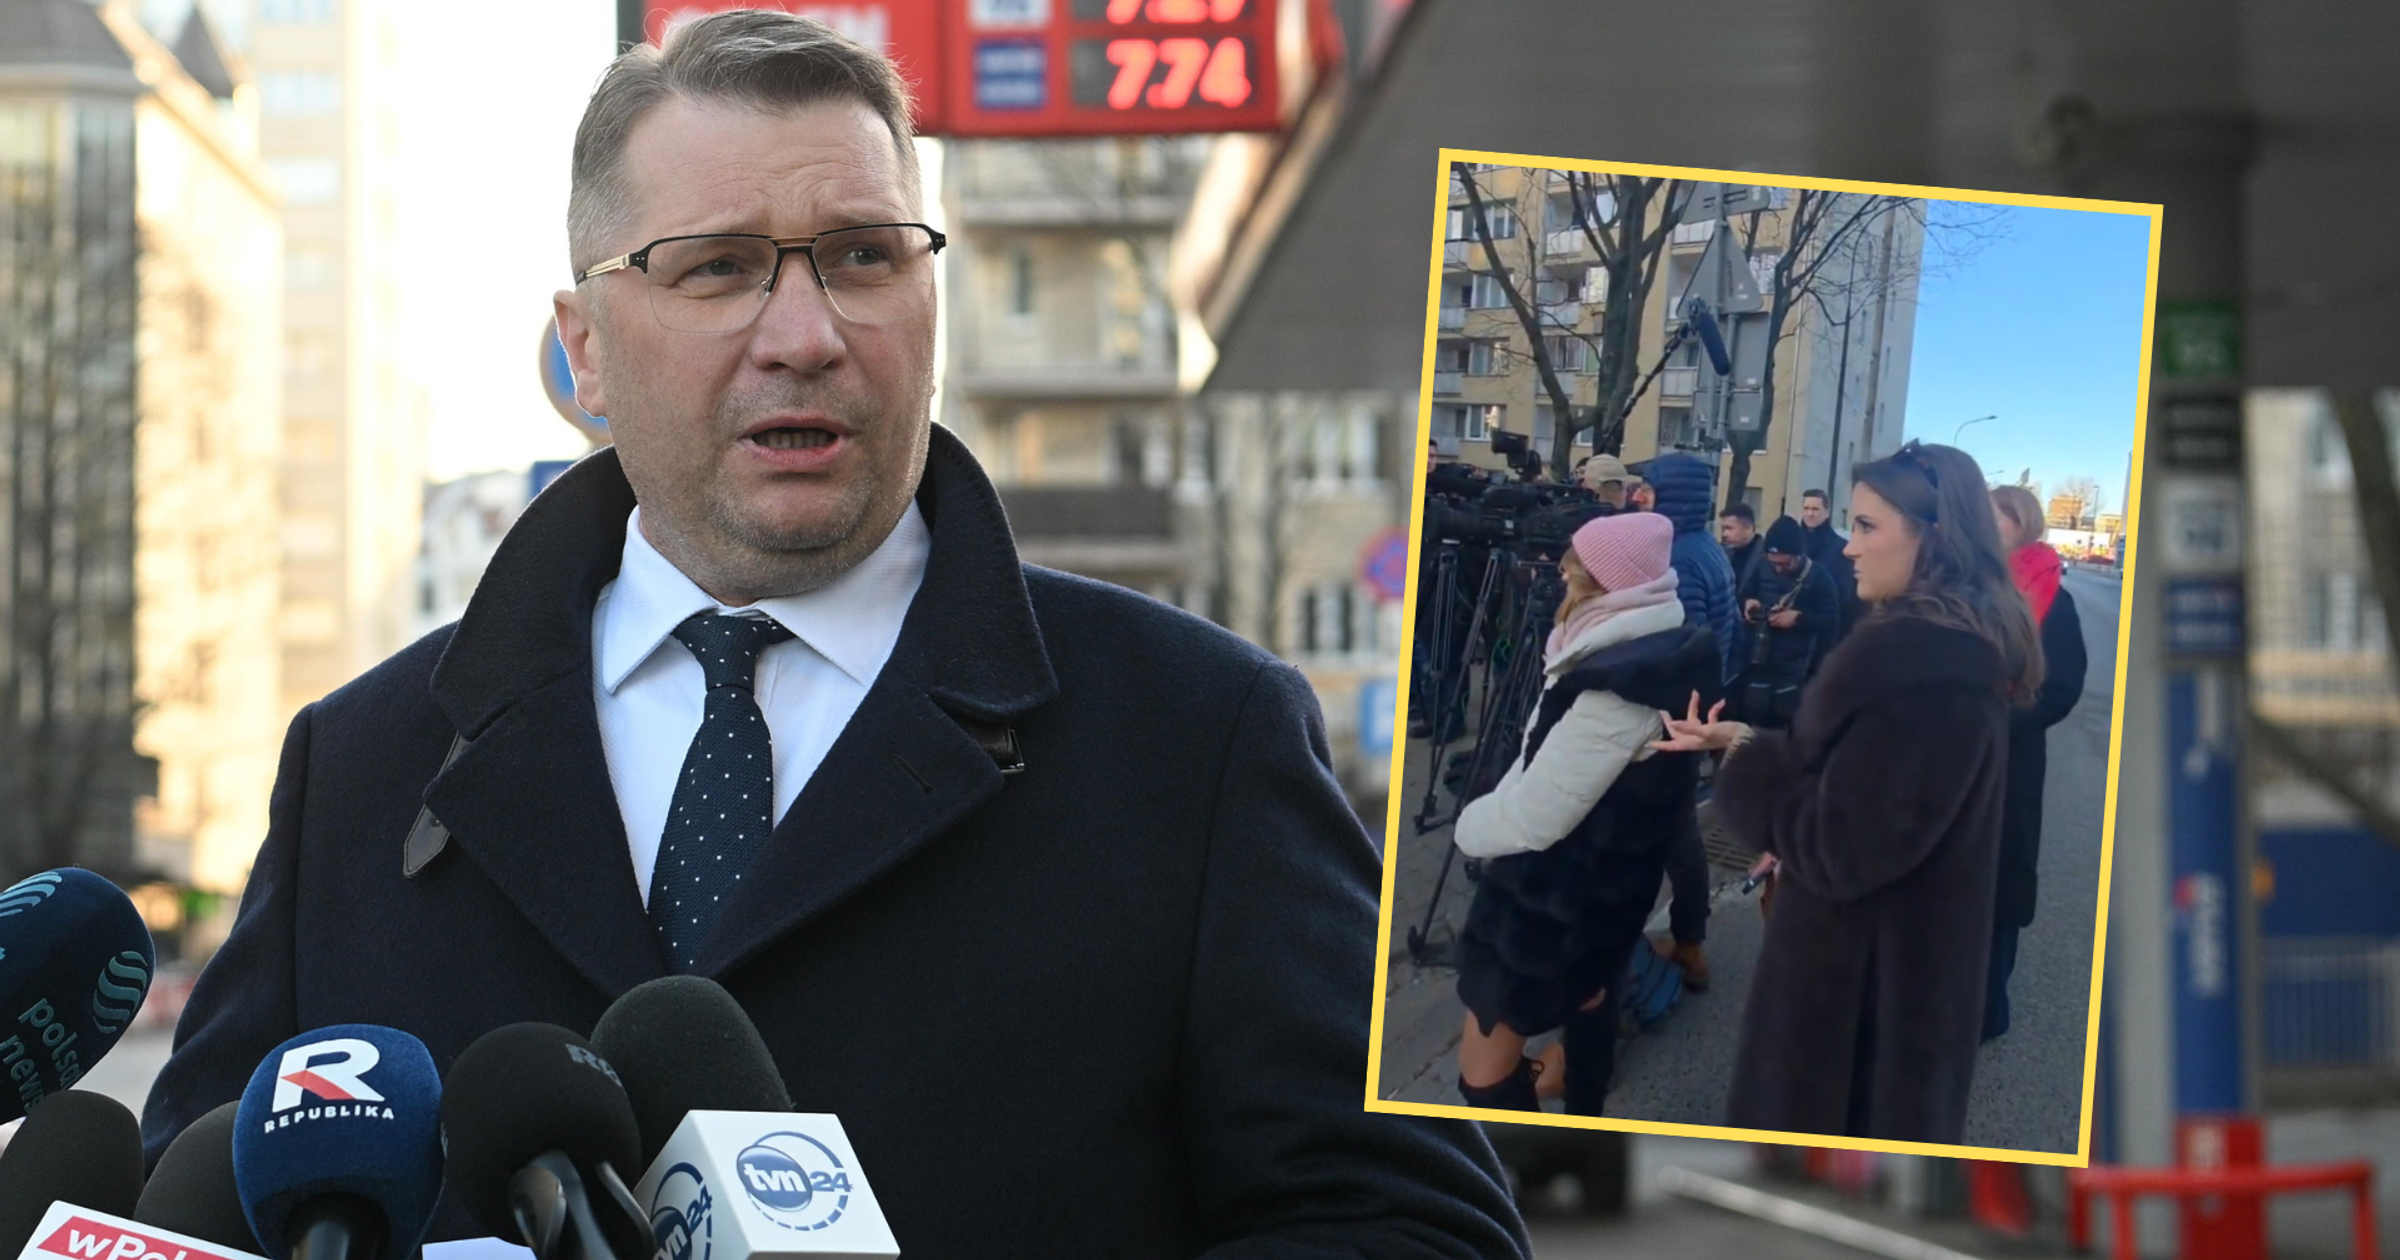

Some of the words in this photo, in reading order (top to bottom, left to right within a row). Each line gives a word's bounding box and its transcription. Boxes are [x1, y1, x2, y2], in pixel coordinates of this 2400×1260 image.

[1106, 37, 1252, 110] 7.74
[18, 997, 84, 1091] polsa
[264, 1105, 395, 1134] REPUBLIKA
